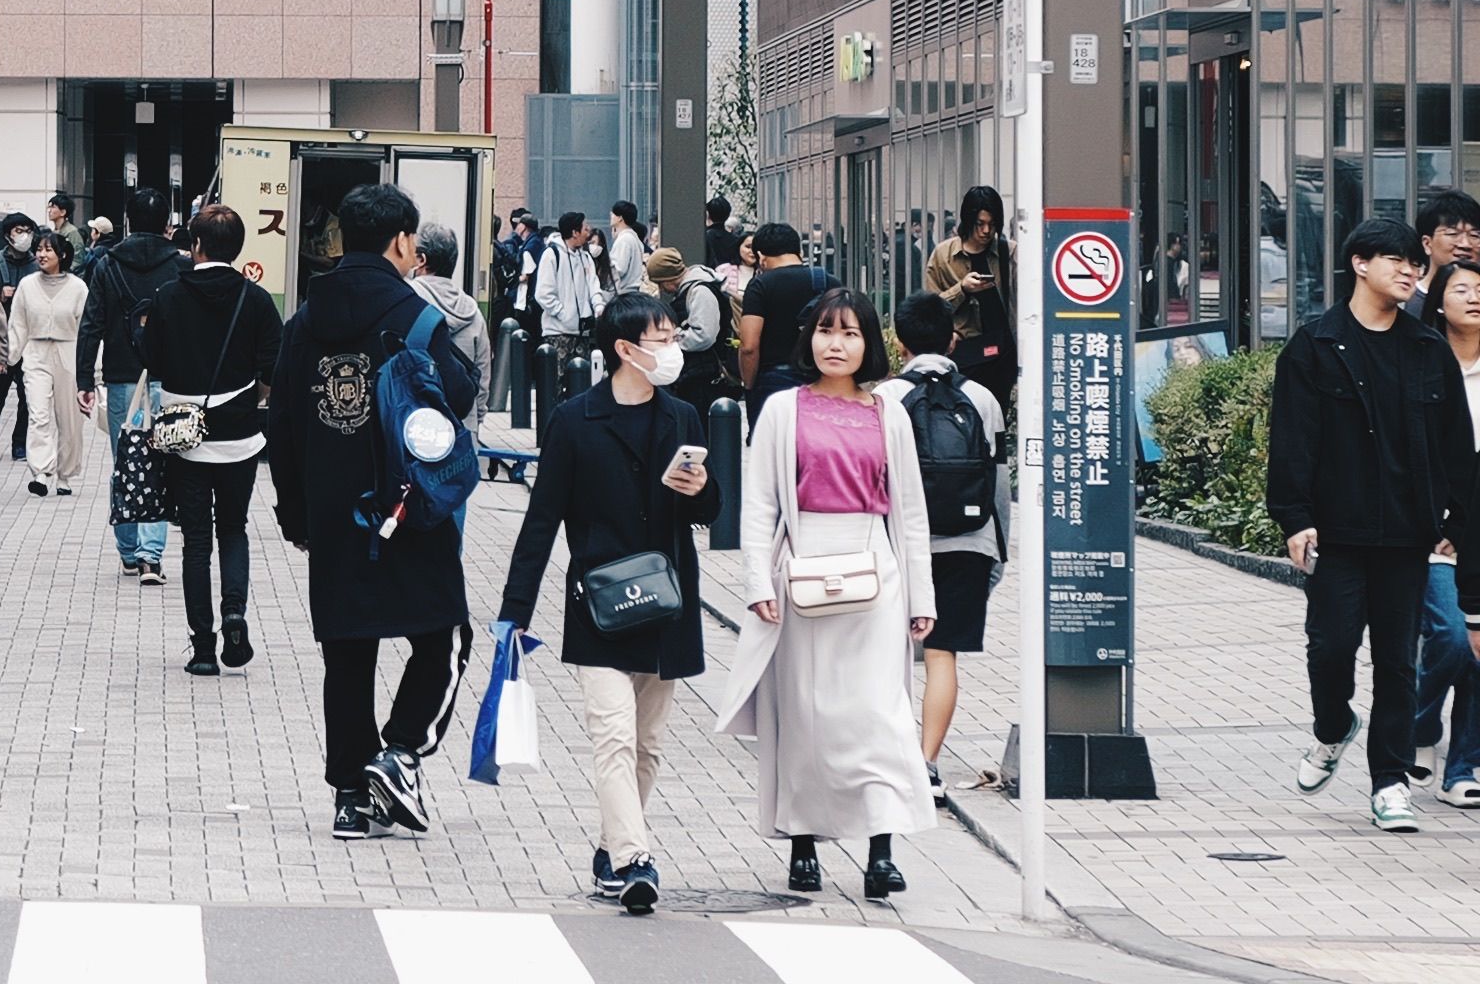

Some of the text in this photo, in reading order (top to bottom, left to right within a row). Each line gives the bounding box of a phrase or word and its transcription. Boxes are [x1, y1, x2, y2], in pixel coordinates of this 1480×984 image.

[1074, 48, 1088, 57] 18
[1072, 59, 1096, 68] 428
[1085, 332, 1110, 486] 路上喫煙禁止
[1067, 333, 1084, 525] No Smoking on the street
[614, 593, 658, 612] FRED PERRY
